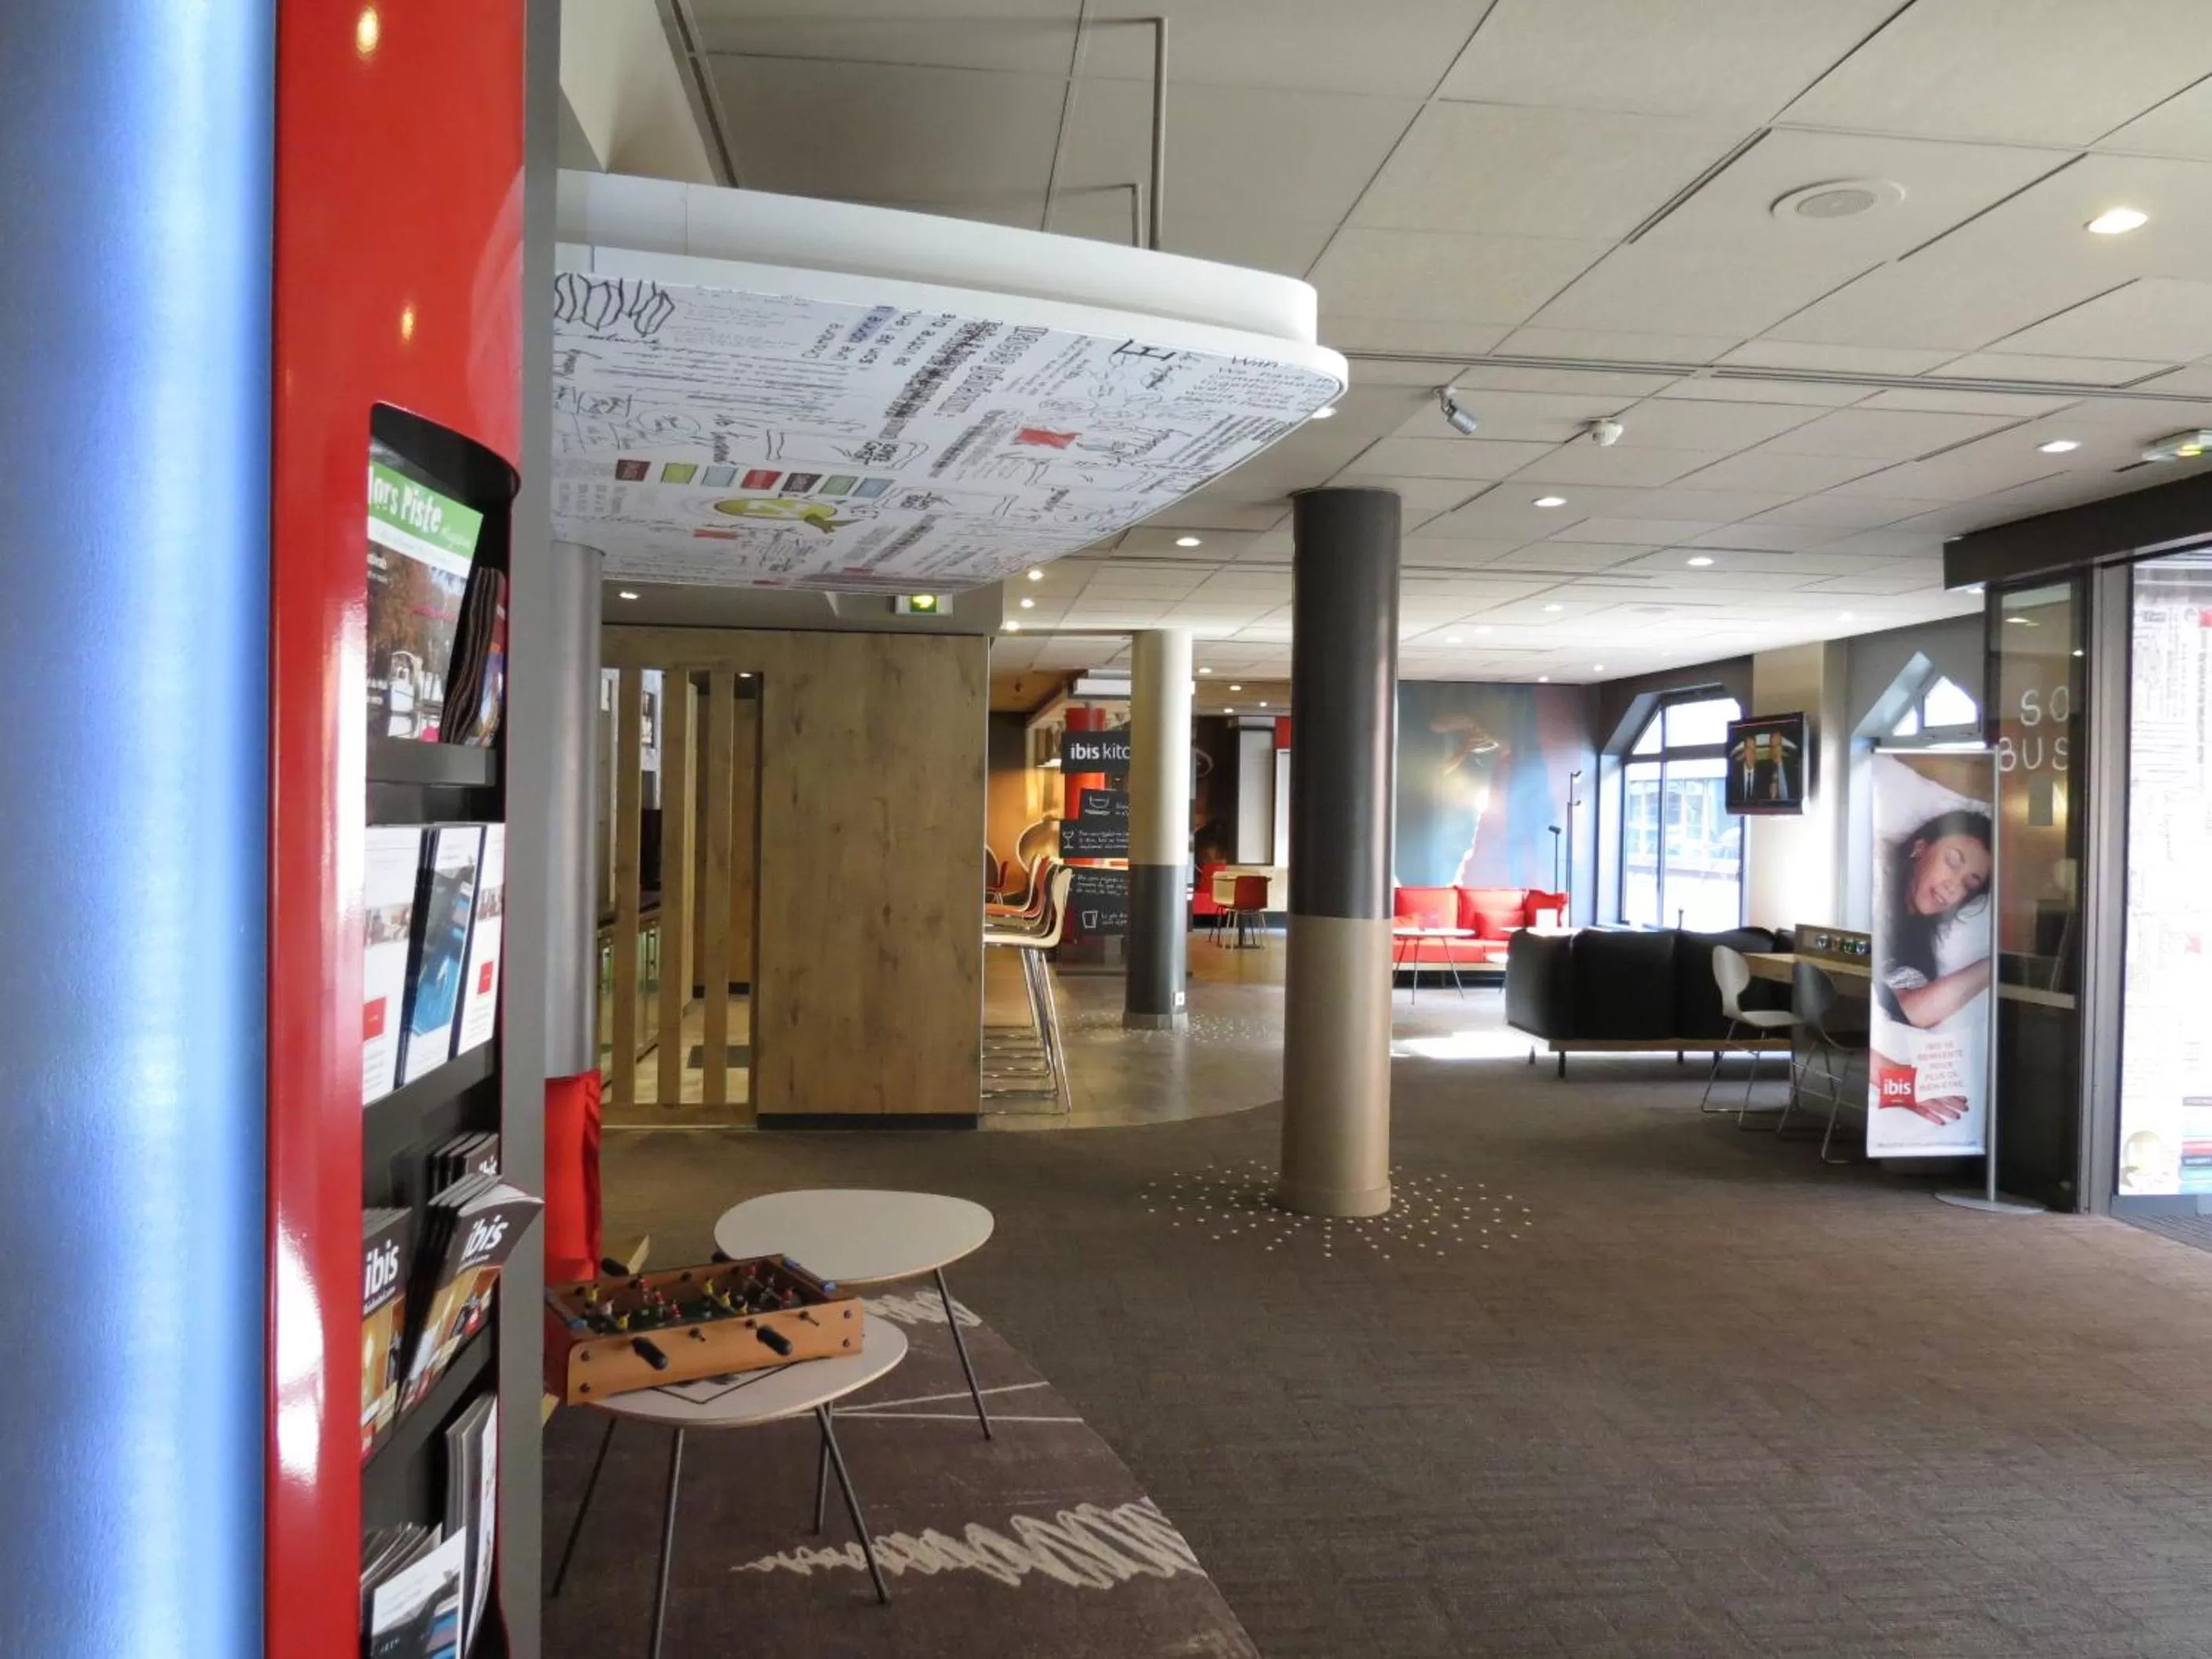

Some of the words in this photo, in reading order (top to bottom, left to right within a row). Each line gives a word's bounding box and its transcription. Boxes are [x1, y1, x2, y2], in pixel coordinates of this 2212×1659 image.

[401, 484, 442, 533] Piste
[2020, 685, 2070, 727] SO
[1071, 742, 1100, 760] ibis
[1102, 742, 1131, 760] kitc
[1999, 736, 2069, 772] BUS
[1884, 1077, 1912, 1096] ibis
[460, 1214, 509, 1261] ibis
[364, 1238, 400, 1301] ibis
